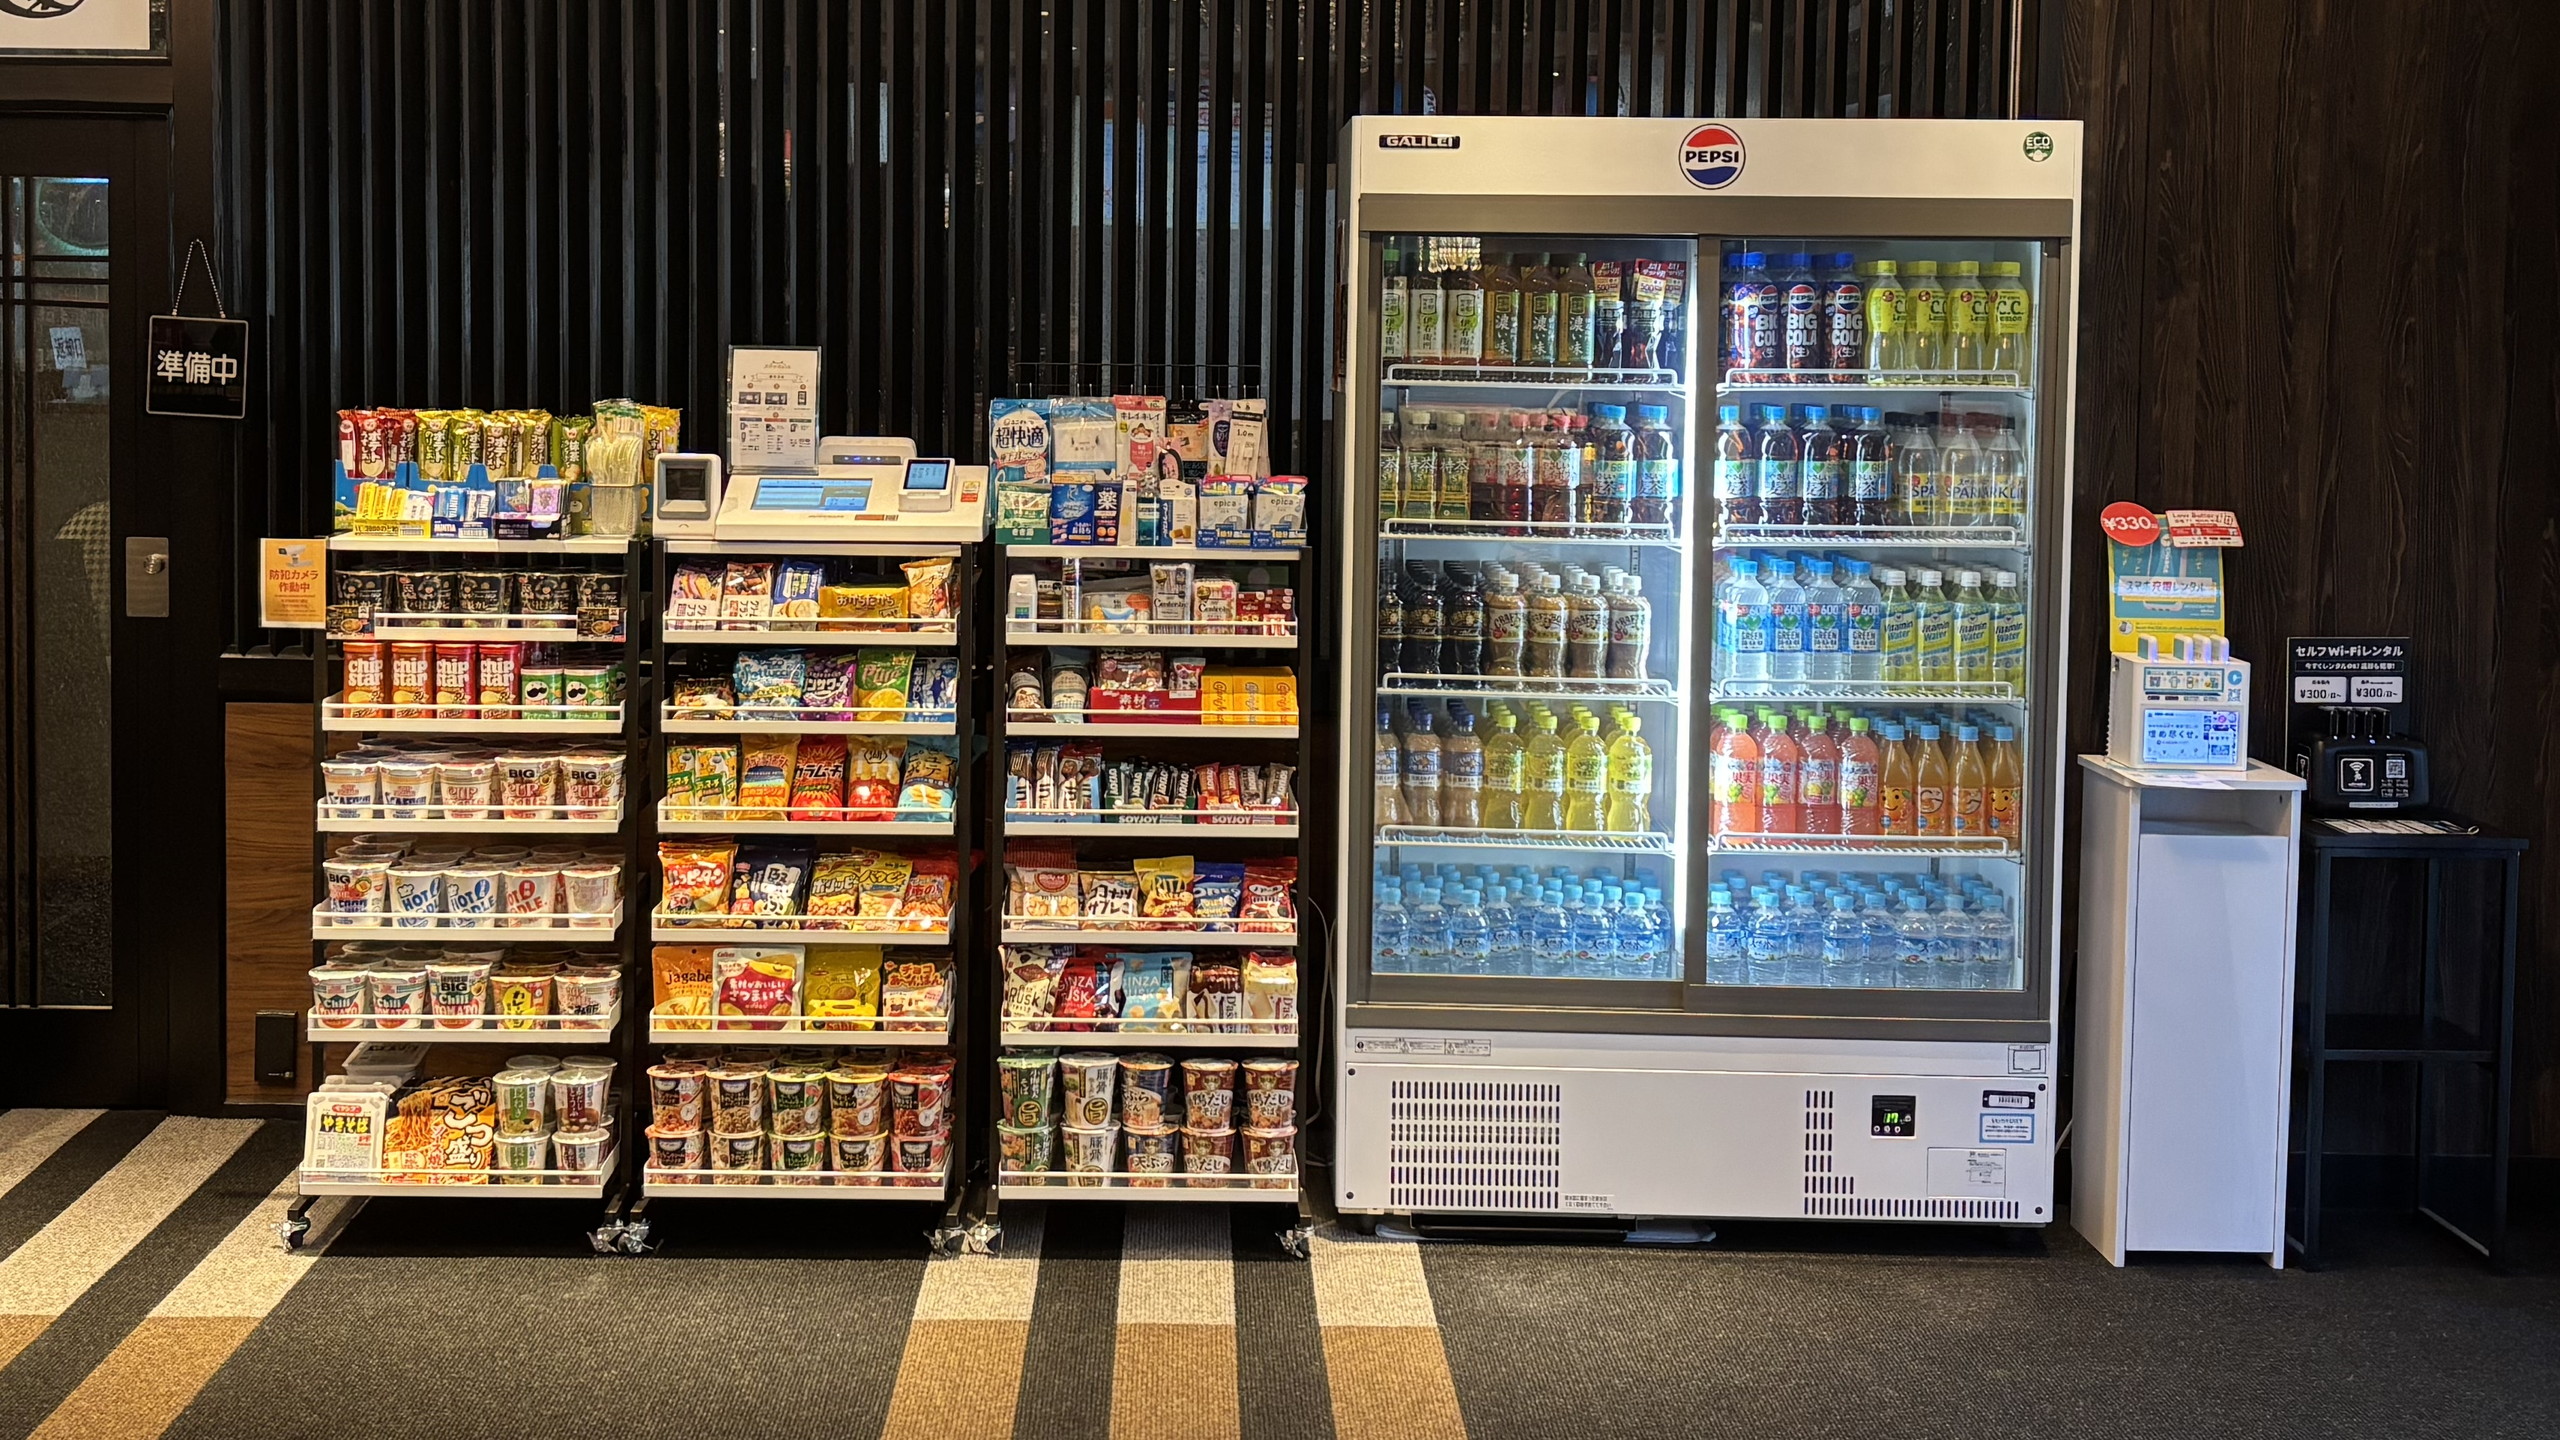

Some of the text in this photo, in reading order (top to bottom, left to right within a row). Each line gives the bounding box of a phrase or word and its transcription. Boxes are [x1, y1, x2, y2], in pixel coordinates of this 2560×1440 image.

[1386, 135, 1454, 147] GALILEI
[2026, 136, 2051, 146] ECO
[1685, 150, 1739, 163] PEPSI
[1788, 314, 1817, 330] BIG
[1833, 314, 1862, 330] BIG
[1996, 314, 2023, 322] Lemon
[1496, 315, 1510, 355] 濃い味
[1533, 315, 1548, 356] 濃い味
[1569, 315, 1583, 356] 濃い味
[1786, 329, 1817, 347] COLA
[1832, 329, 1862, 347] COLA
[157, 350, 237, 385] 準備中
[995, 426, 1045, 449] 超快適
[369, 430, 381, 463] ポテト
[434, 431, 446, 463] ポテト
[495, 435, 507, 469] ポテト
[1406, 457, 1435, 472] 特茶
[1441, 457, 1469, 473] 特茶
[1213, 500, 1237, 508] epica
[1270, 498, 1294, 507] epica
[2103, 515, 2152, 531] ¥330
[269, 569, 319, 581] 防犯カメラ
[279, 582, 310, 592] 作動中
[2125, 580, 2205, 593] スマホ充電レンタル
[837, 593, 894, 607] おからだから
[1749, 605, 1770, 614] 600
[1784, 605, 1802, 615] 600
[1820, 605, 1839, 615] 600
[1861, 605, 1880, 615] 600
[1741, 631, 1763, 640] GREEN
[1777, 631, 1800, 640] GREEN
[1813, 631, 1837, 640] GREEN
[1852, 631, 1876, 640] GREEN
[1887, 630, 1910, 640] Water
[1923, 631, 1947, 641] Water
[1961, 632, 1985, 642] Water
[1996, 632, 2021, 642] Water
[2295, 645, 2403, 658] セルフWi-Fiレンタル
[348, 659, 383, 674] chip
[392, 659, 429, 674] chip
[436, 659, 470, 675] chip
[480, 659, 515, 675] chip
[348, 672, 383, 688] star
[393, 672, 429, 688] star
[437, 673, 470, 689] star
[480, 673, 515, 689] star
[1119, 693, 1146, 705] 素材
[508, 769, 535, 778] BIG
[571, 770, 597, 780] BIG
[447, 786, 479, 799] CUP
[1119, 815, 1159, 824] SOYJOY
[1212, 815, 1251, 825] SOYJOY
[329, 873, 351, 884] BIG
[1154, 876, 1186, 895] RITZ
[402, 890, 429, 912] HOT
[900, 963, 934, 976] チョコ
[441, 982, 469, 992] BIG
[1058, 976, 1095, 990] GINZA
[727, 988, 785, 1002] さつまいも
[1201, 1106, 1219, 1118] そば
[1260, 1106, 1276, 1117] そば
[320, 1114, 371, 1134] やきそば
